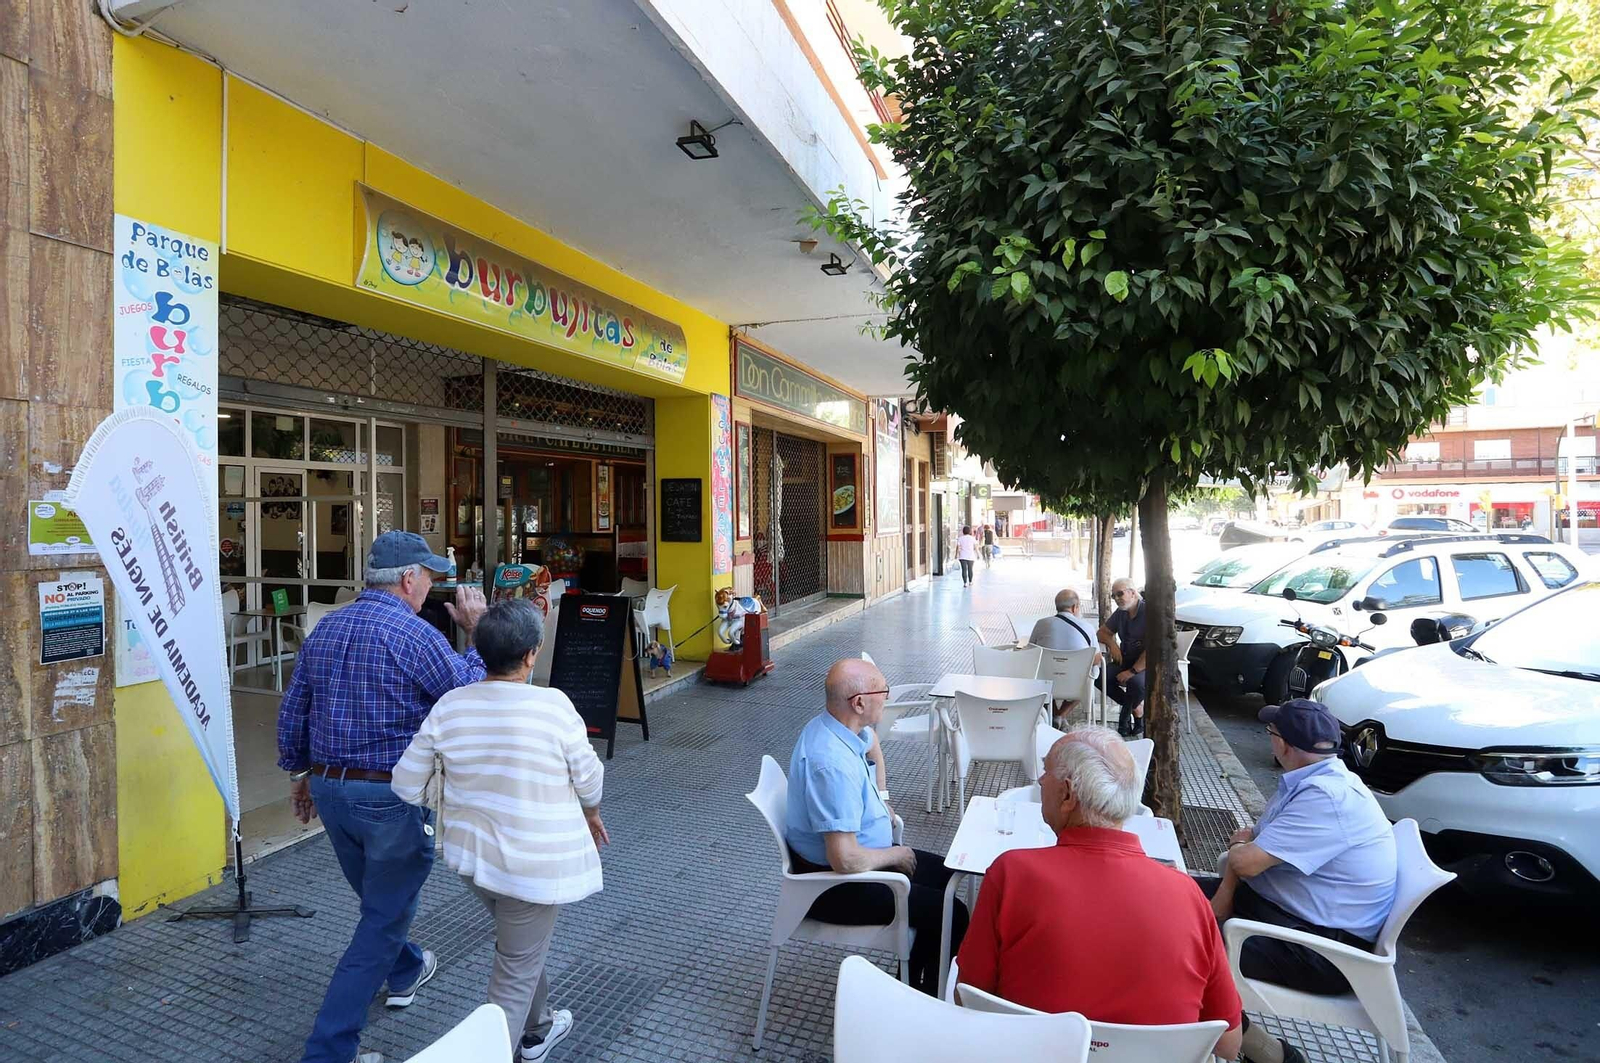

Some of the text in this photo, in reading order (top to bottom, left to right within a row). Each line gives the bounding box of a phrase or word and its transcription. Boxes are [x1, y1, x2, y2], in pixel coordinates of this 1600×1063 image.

[131, 222, 209, 261] Parque
[121, 250, 148, 273] de
[442, 232, 635, 347] burbujitas
[119, 302, 153, 315] JUEGOS
[121, 357, 151, 367] FIESTA
[741, 353, 769, 395] Don
[177, 373, 212, 395] REGALOS
[1408, 489, 1460, 498] vodafone
[45, 594, 65, 604] NO
[582, 607, 607, 615] OQUENDO
